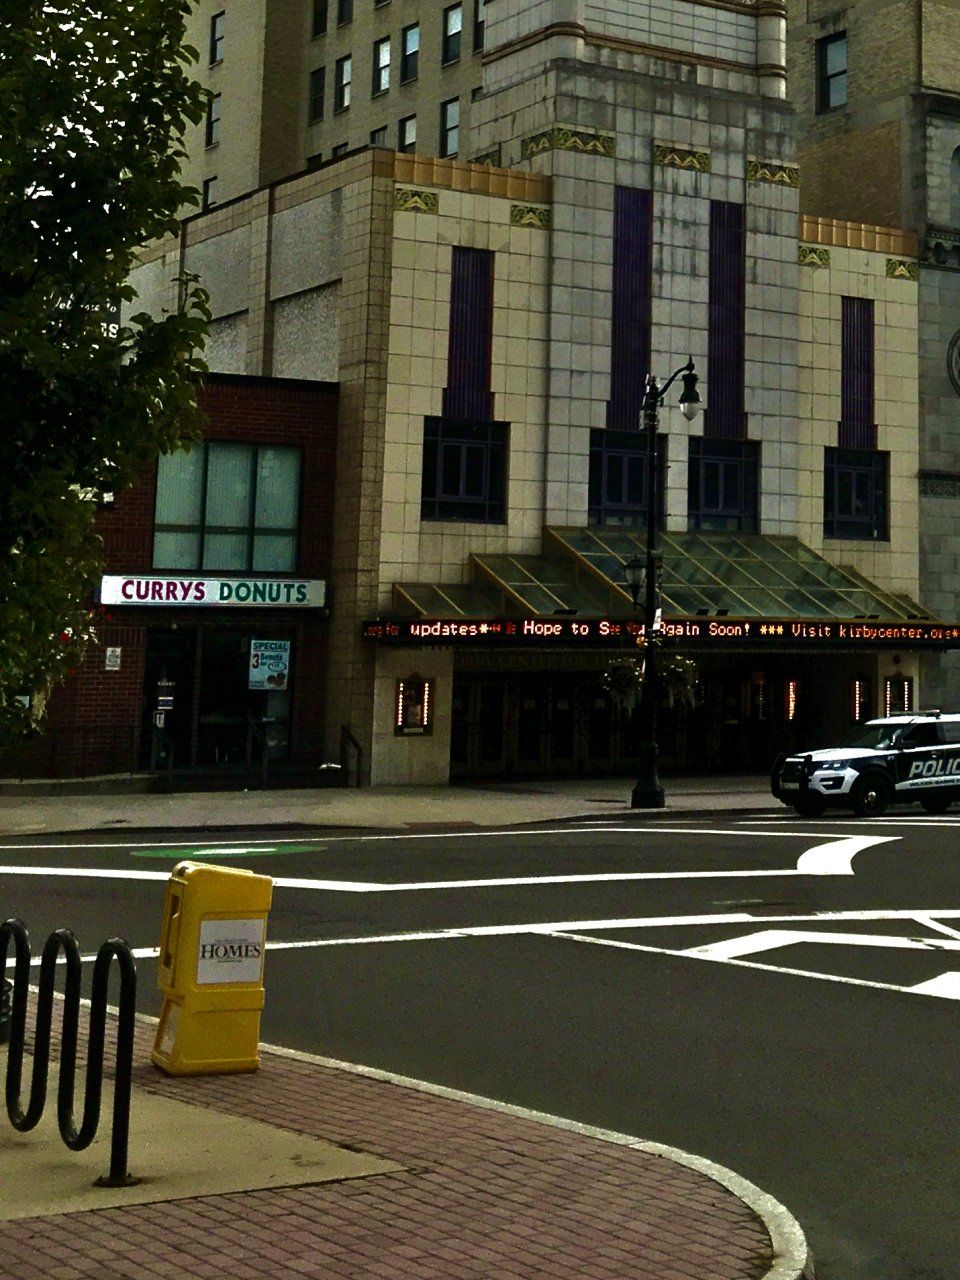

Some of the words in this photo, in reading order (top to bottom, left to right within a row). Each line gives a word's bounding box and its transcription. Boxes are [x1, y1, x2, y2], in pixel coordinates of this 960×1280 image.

[121, 579, 205, 601] CURRYS
[219, 581, 307, 603] DONUTS
[523, 620, 563, 637] Hope
[571, 622, 589, 636] to
[708, 621, 750, 636] Soon!
[791, 623, 831, 638] Visit
[252, 641, 289, 651] SPECIAL
[251, 653, 260, 669] 3
[201, 943, 261, 959] HOMES
